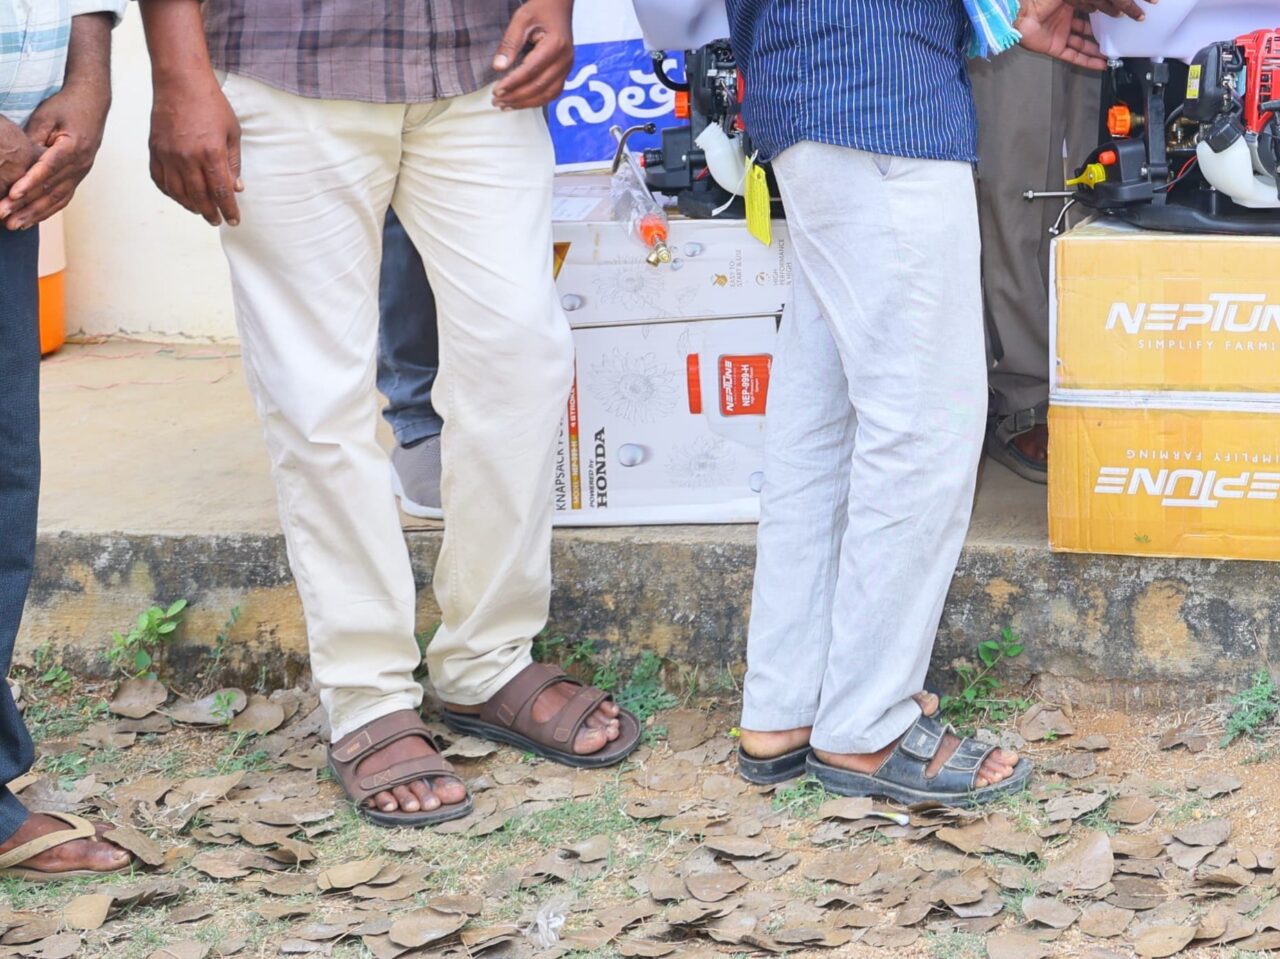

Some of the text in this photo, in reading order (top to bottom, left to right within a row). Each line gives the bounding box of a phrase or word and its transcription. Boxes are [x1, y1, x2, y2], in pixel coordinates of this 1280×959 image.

[1138, 339, 1214, 350] SIMPLIFY
[723, 360, 734, 411] NEPTUNE
[741, 364, 751, 407] NEP-999-H
[594, 427, 608, 509] HONDA
[1127, 449, 1203, 461] FARMING
